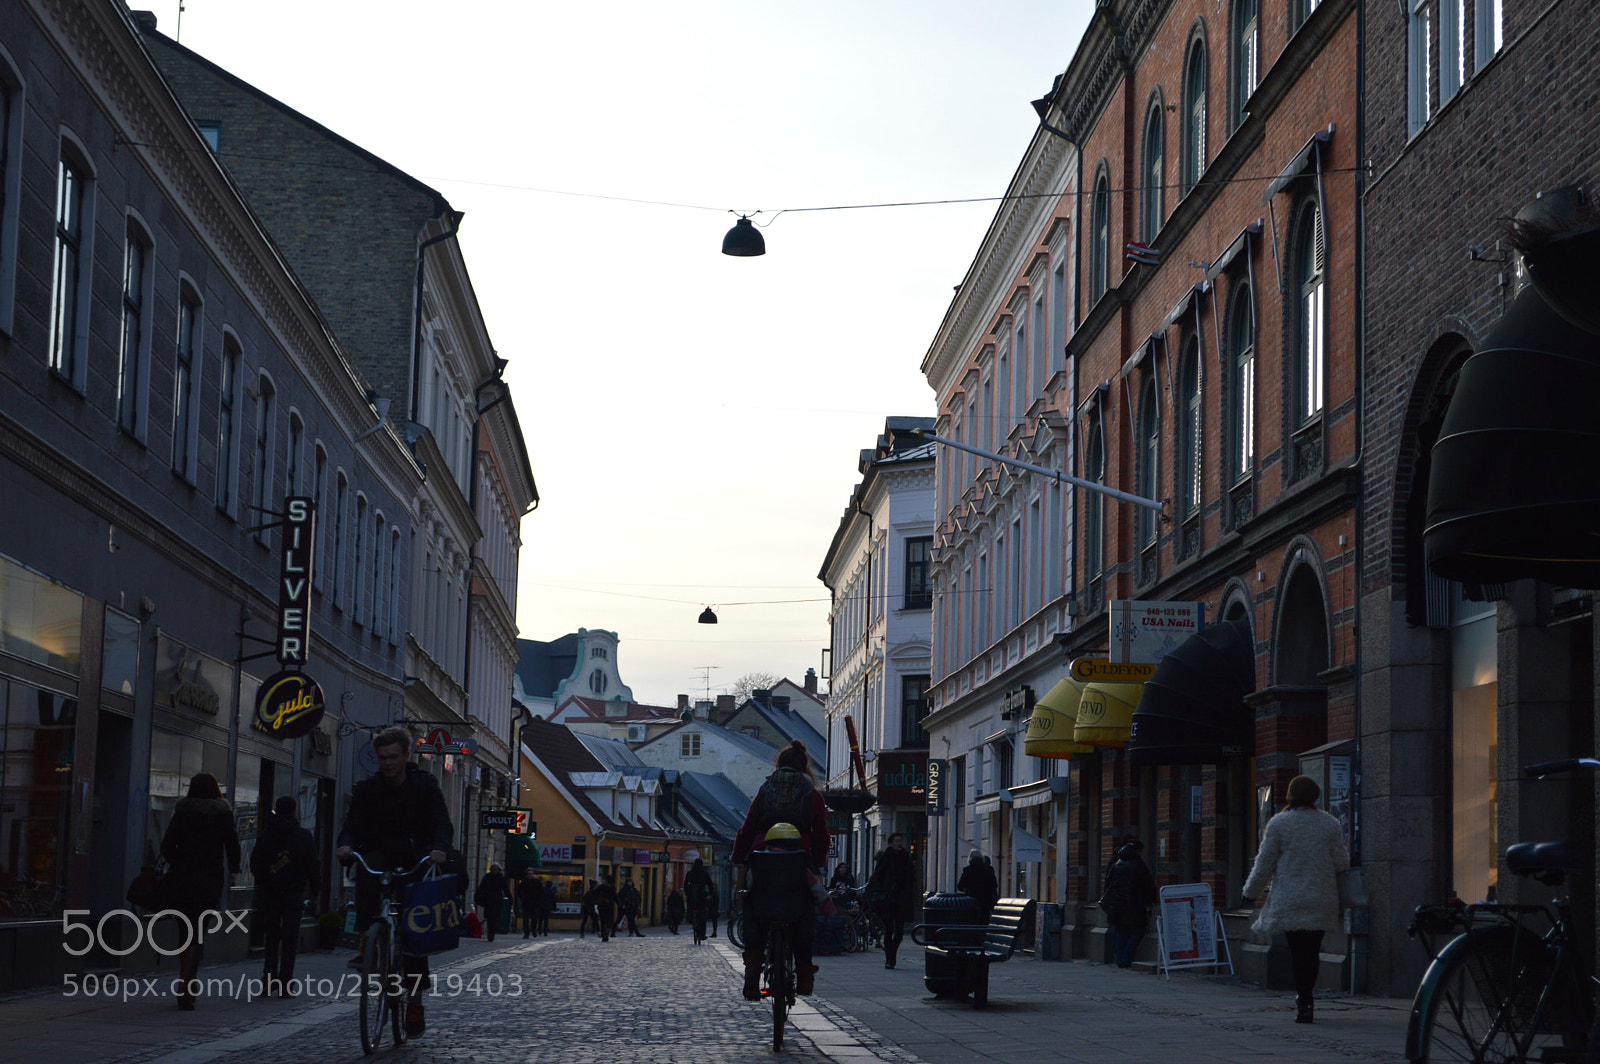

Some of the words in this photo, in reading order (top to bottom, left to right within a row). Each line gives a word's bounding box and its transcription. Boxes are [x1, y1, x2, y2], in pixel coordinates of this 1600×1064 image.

[281, 500, 308, 661] SILVER
[1142, 617, 1164, 627] USA
[1167, 618, 1195, 628] Nails
[1077, 661, 1152, 678] GULDFYND
[259, 676, 322, 730] Guld
[884, 763, 925, 787] udda
[927, 761, 940, 807] GRANIT
[486, 816, 513, 825] SKULT
[540, 847, 570, 860] AME
